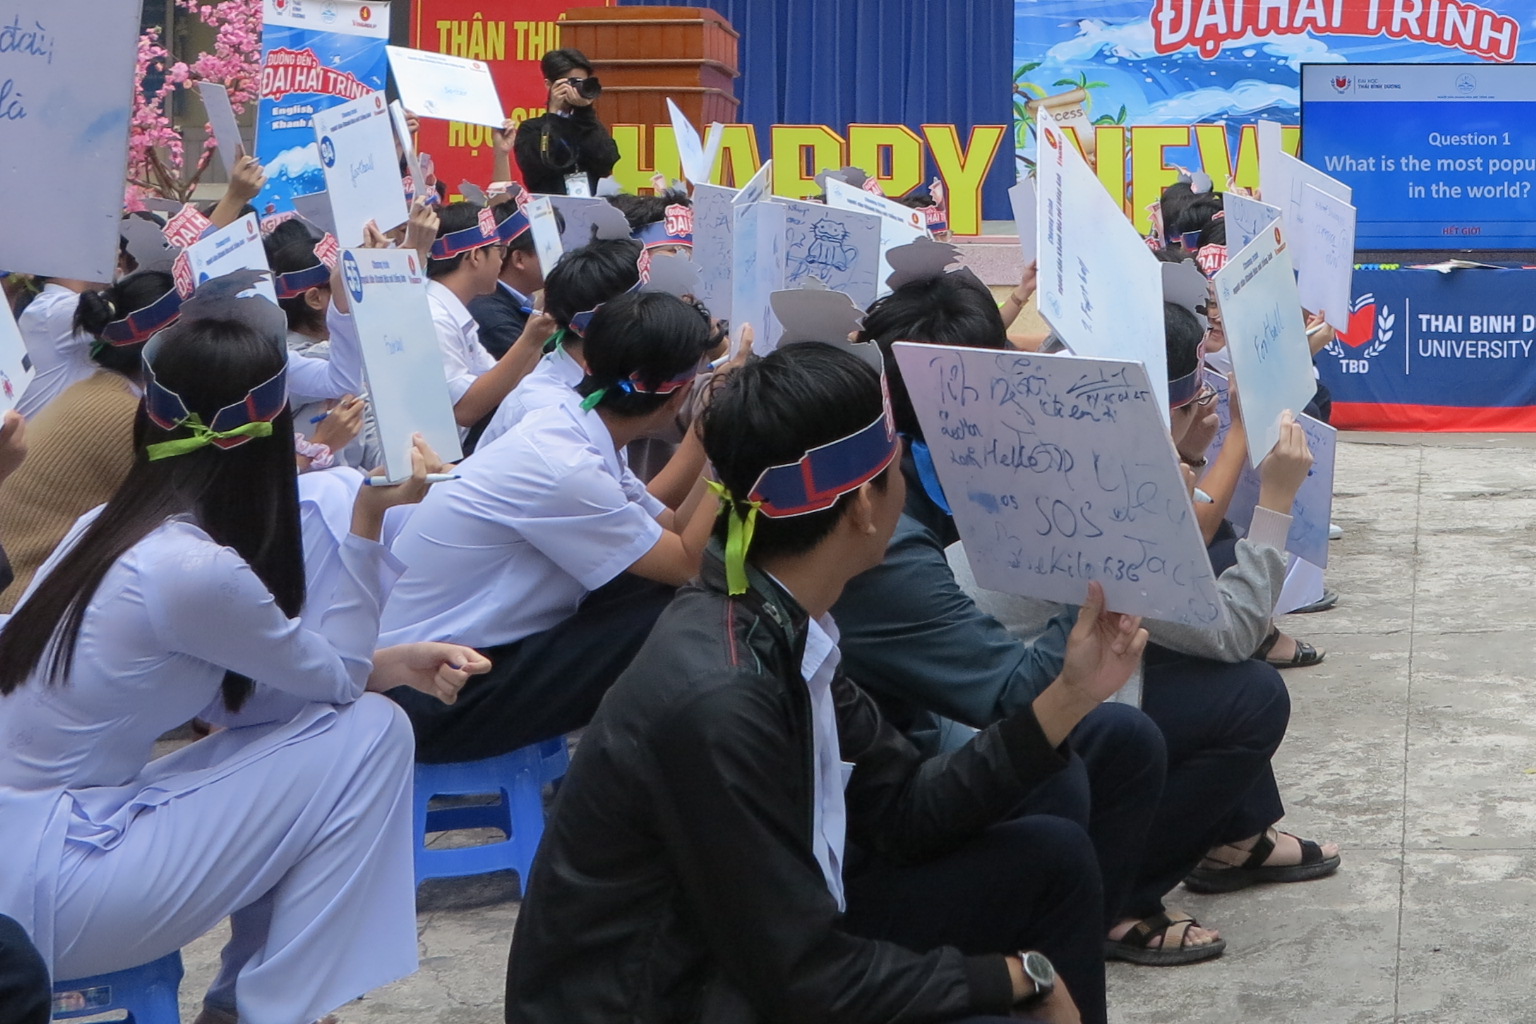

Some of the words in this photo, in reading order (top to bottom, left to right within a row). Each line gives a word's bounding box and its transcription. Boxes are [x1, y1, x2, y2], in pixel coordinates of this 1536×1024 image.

[437, 12, 505, 61] THÂN
[271, 106, 313, 117] English
[271, 119, 307, 131] Khanh
[1428, 132, 1497, 148] Question
[1503, 133, 1511, 145] 1
[1324, 155, 1376, 172] What
[1381, 155, 1395, 172] is
[1400, 155, 1431, 172] the
[1437, 157, 1483, 172] most
[1408, 182, 1426, 198] in
[1430, 181, 1462, 198] the
[1467, 181, 1531, 198] world?
[1417, 314, 1463, 334] THAI
[1470, 314, 1516, 334] BINH
[1418, 339, 1533, 359] UNIVERSITY
[1339, 359, 1369, 374] TBD
[1035, 491, 1103, 538] SOS
